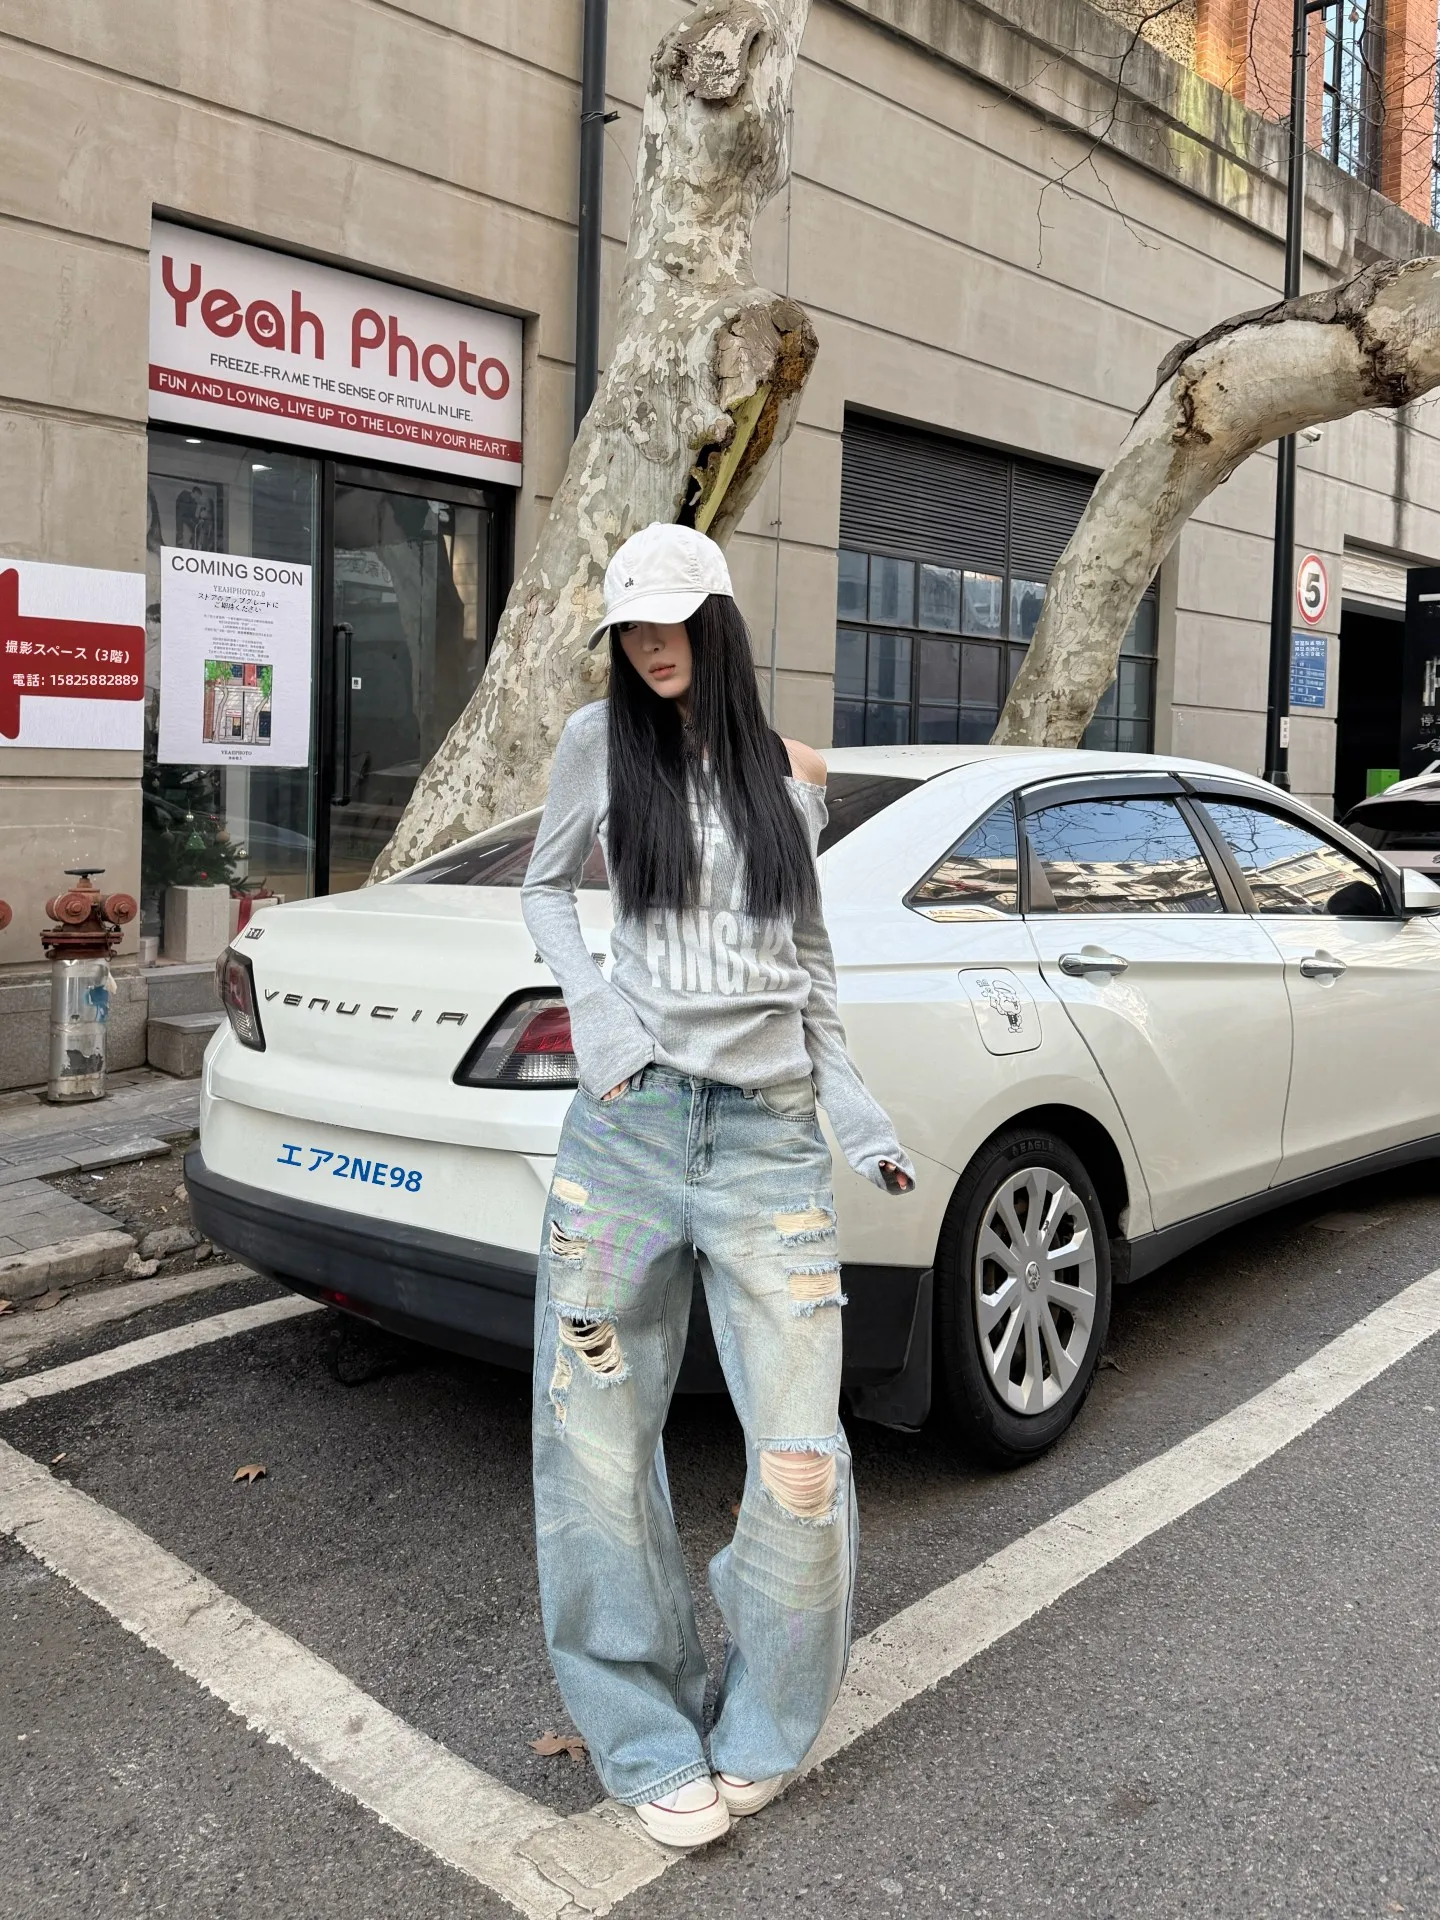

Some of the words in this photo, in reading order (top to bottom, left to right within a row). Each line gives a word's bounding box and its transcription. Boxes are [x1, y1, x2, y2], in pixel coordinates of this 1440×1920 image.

[162, 255, 325, 361] Yeah
[351, 308, 510, 401] Photo
[210, 353, 310, 386] FREEZE-FRAME
[312, 376, 336, 392] THE
[338, 382, 376, 400] SENSE
[378, 391, 394, 404] OF
[396, 395, 436, 414] RITUAL
[438, 404, 448, 416] IN
[450, 406, 474, 422] LIFE.
[159, 373, 187, 391] FUN
[191, 381, 223, 398] AND
[227, 389, 284, 413] LOVING,
[287, 400, 315, 417] LIVE
[318, 407, 334, 420] UP
[338, 411, 357, 426] TO
[361, 416, 384, 431] THE
[387, 421, 419, 439] LOVE
[421, 428, 433, 441] IN
[435, 430, 467, 449] YOUR
[469, 438, 510, 456] HEART.
[171, 555, 248, 579] COMING
[253, 566, 303, 586] SOON
[213, 585, 266, 598] YEAHPHOTO2.0
[1304, 572, 1321, 609] 5
[50, 674, 139, 686] 15825882889
[646, 907, 790, 995] FINGER
